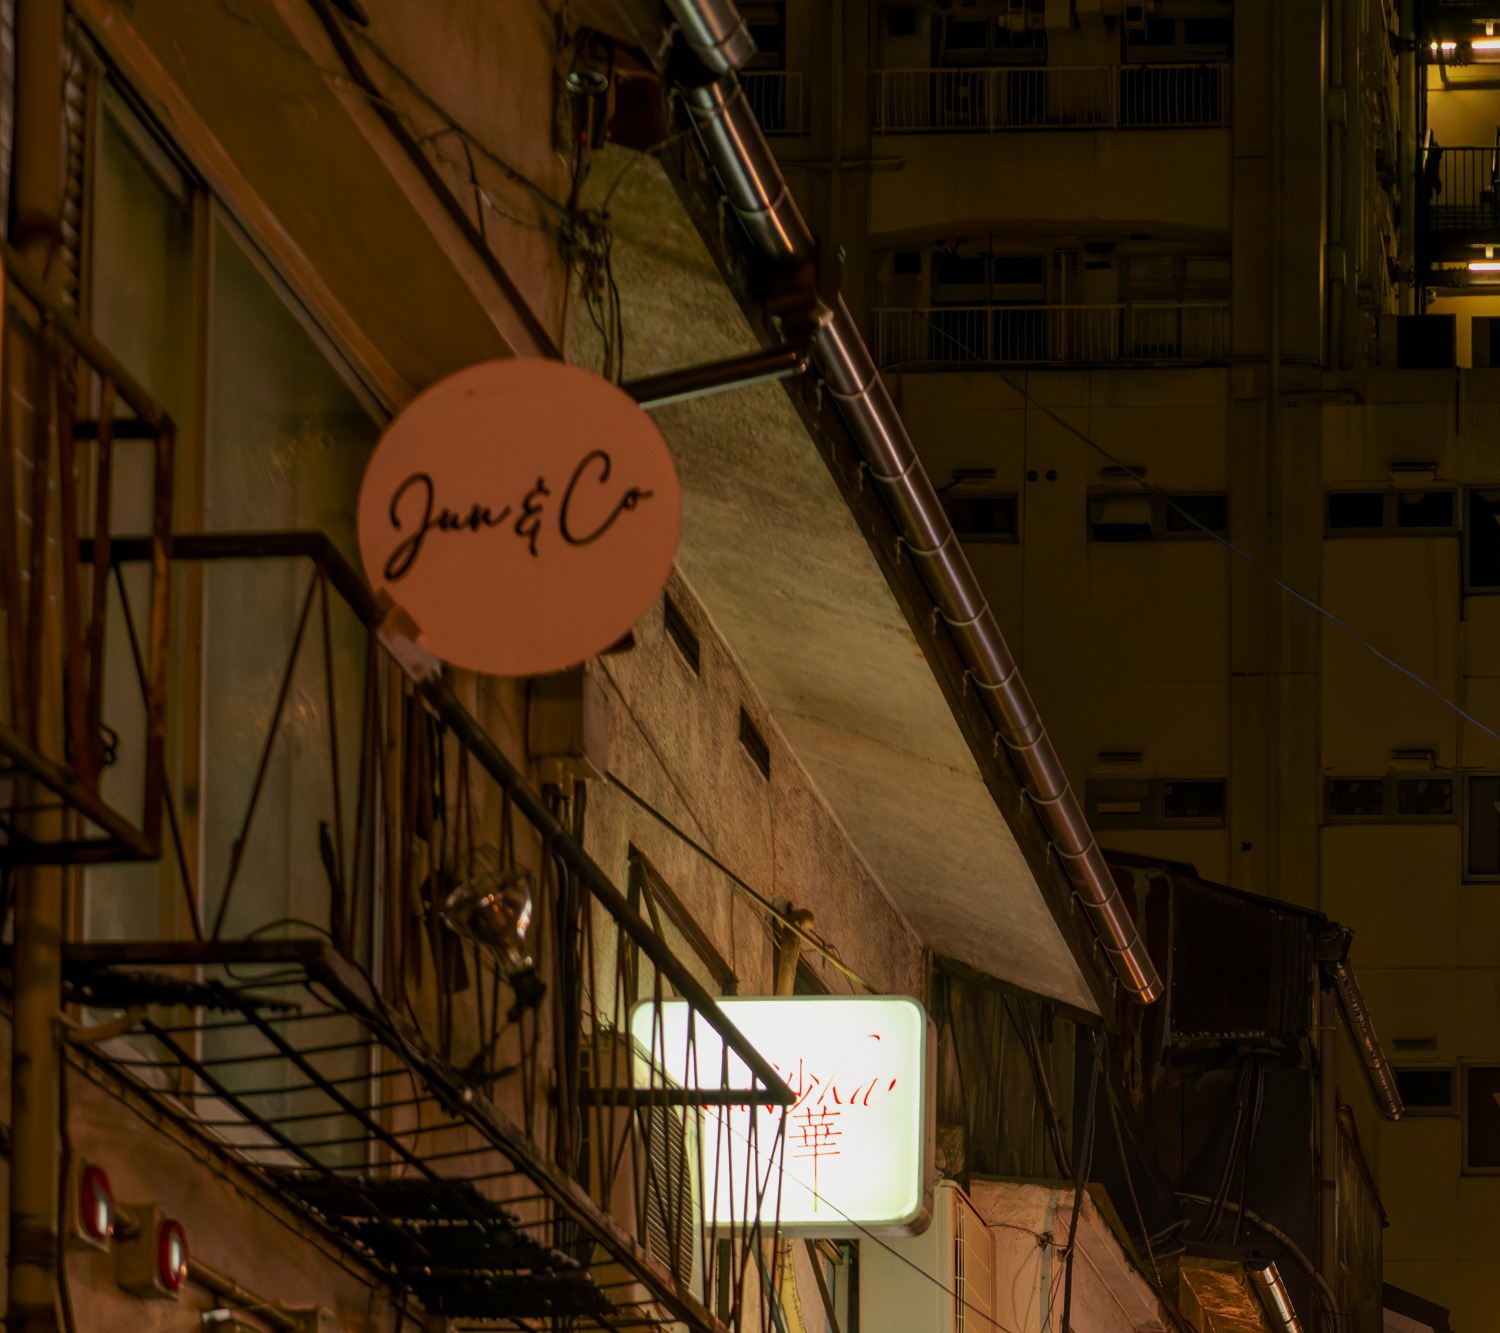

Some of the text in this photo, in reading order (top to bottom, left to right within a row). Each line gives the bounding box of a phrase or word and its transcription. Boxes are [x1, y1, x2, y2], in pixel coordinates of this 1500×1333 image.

[385, 449, 655, 581] Jun & Co
